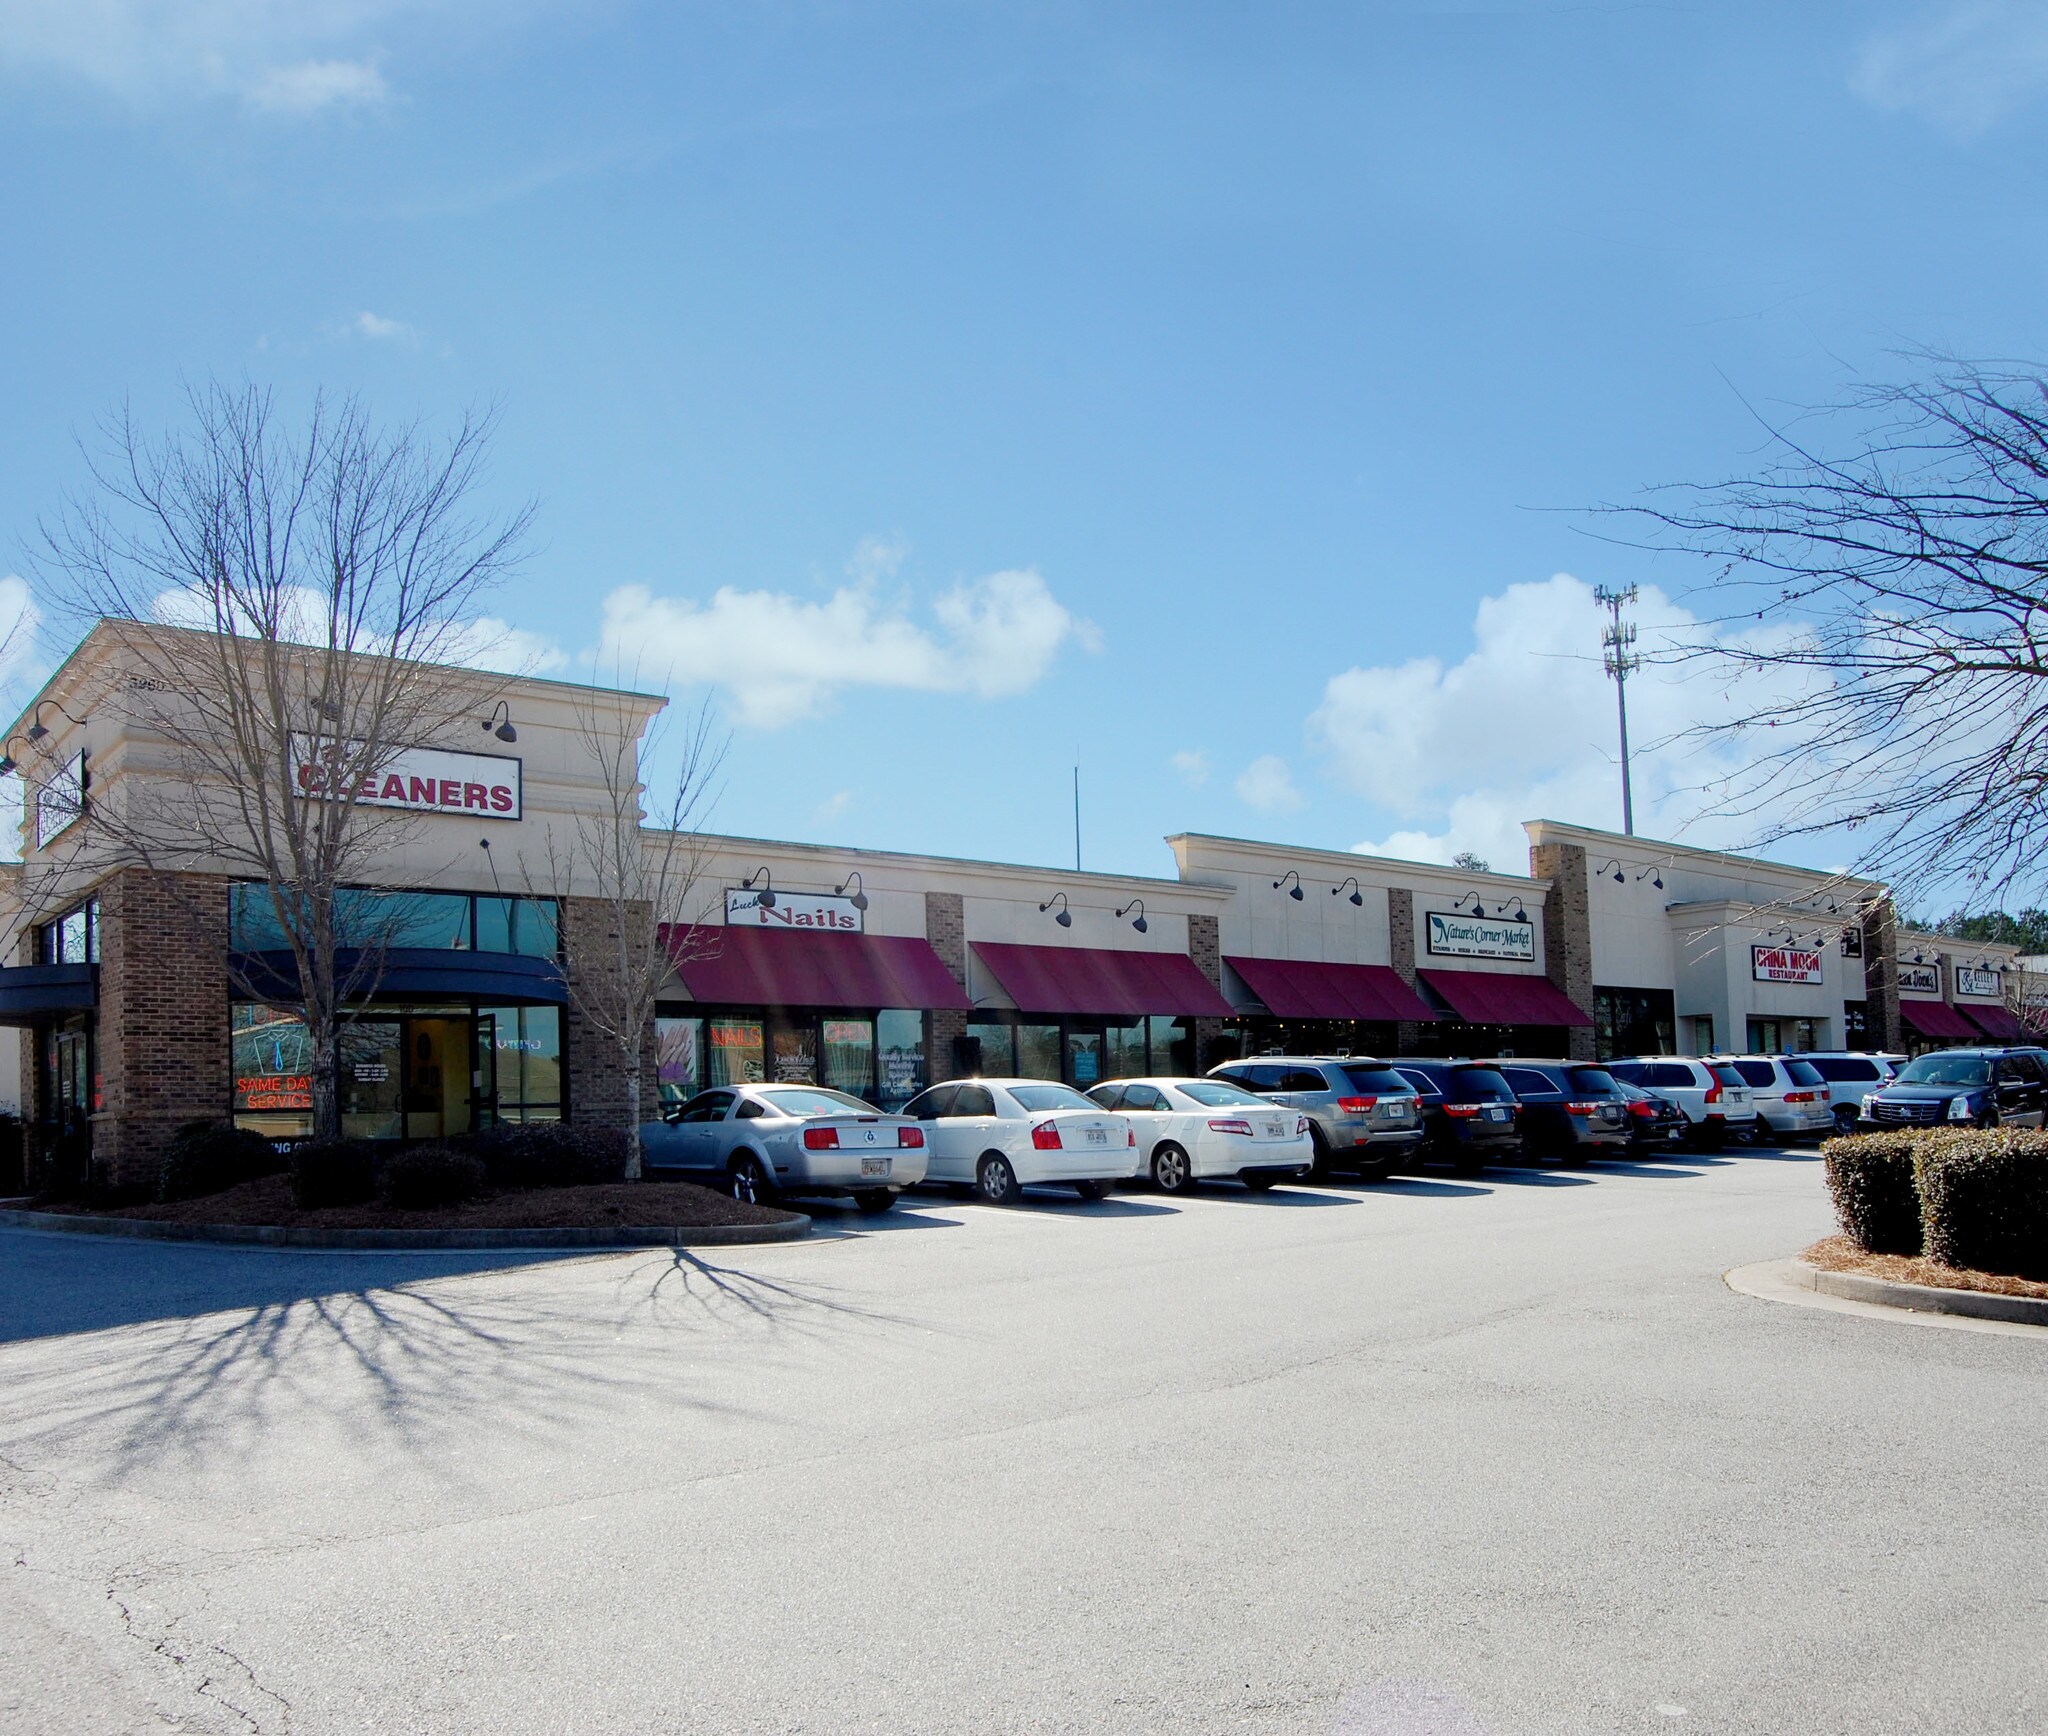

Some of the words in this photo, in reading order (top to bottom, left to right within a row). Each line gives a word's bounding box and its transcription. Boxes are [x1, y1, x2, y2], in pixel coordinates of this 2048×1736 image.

[729, 895, 763, 912] Luck
[759, 905, 855, 928] Nails
[1434, 922, 1475, 943] Nature's
[1475, 926, 1501, 944] Corner
[1502, 927, 1530, 948] Market
[1756, 948, 1787, 969] CHINA
[1790, 951, 1819, 971] MOON
[1768, 969, 1808, 981] RESTAURANT
[710, 1026, 761, 1046] NAILS
[825, 1024, 870, 1042] OPEN
[238, 1077, 281, 1093] SAME
[247, 1093, 311, 1109] SERVICE
